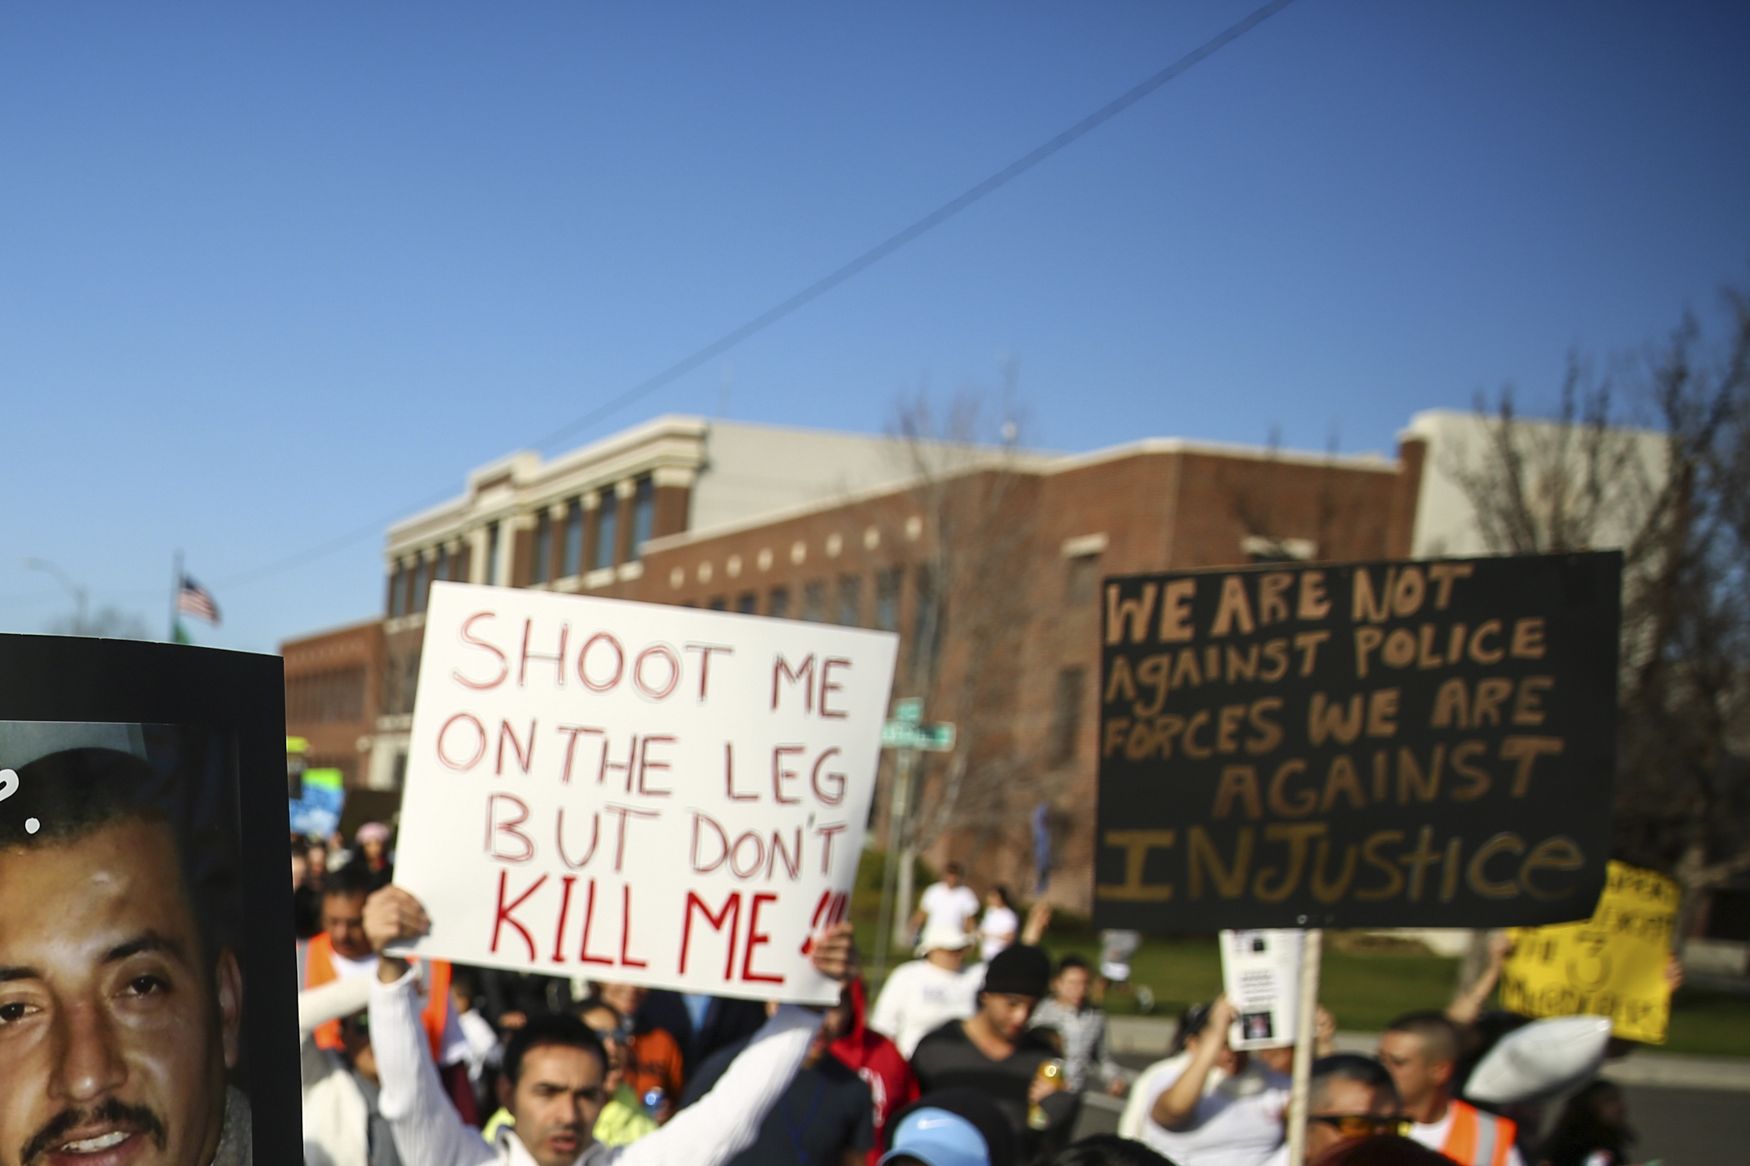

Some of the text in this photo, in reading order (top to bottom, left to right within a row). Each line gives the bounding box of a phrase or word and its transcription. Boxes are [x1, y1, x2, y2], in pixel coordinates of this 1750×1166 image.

[1106, 564, 1473, 645] WE ARE NOT
[1355, 617, 1547, 678] POLICE
[454, 612, 853, 719] SHOOT ME
[437, 713, 847, 805] ON THE LEG
[1102, 676, 1554, 759] FORCES WE ARE
[1212, 735, 1564, 820] AGAINST
[484, 791, 848, 881] BUT DON'T
[491, 869, 647, 967] KILL
